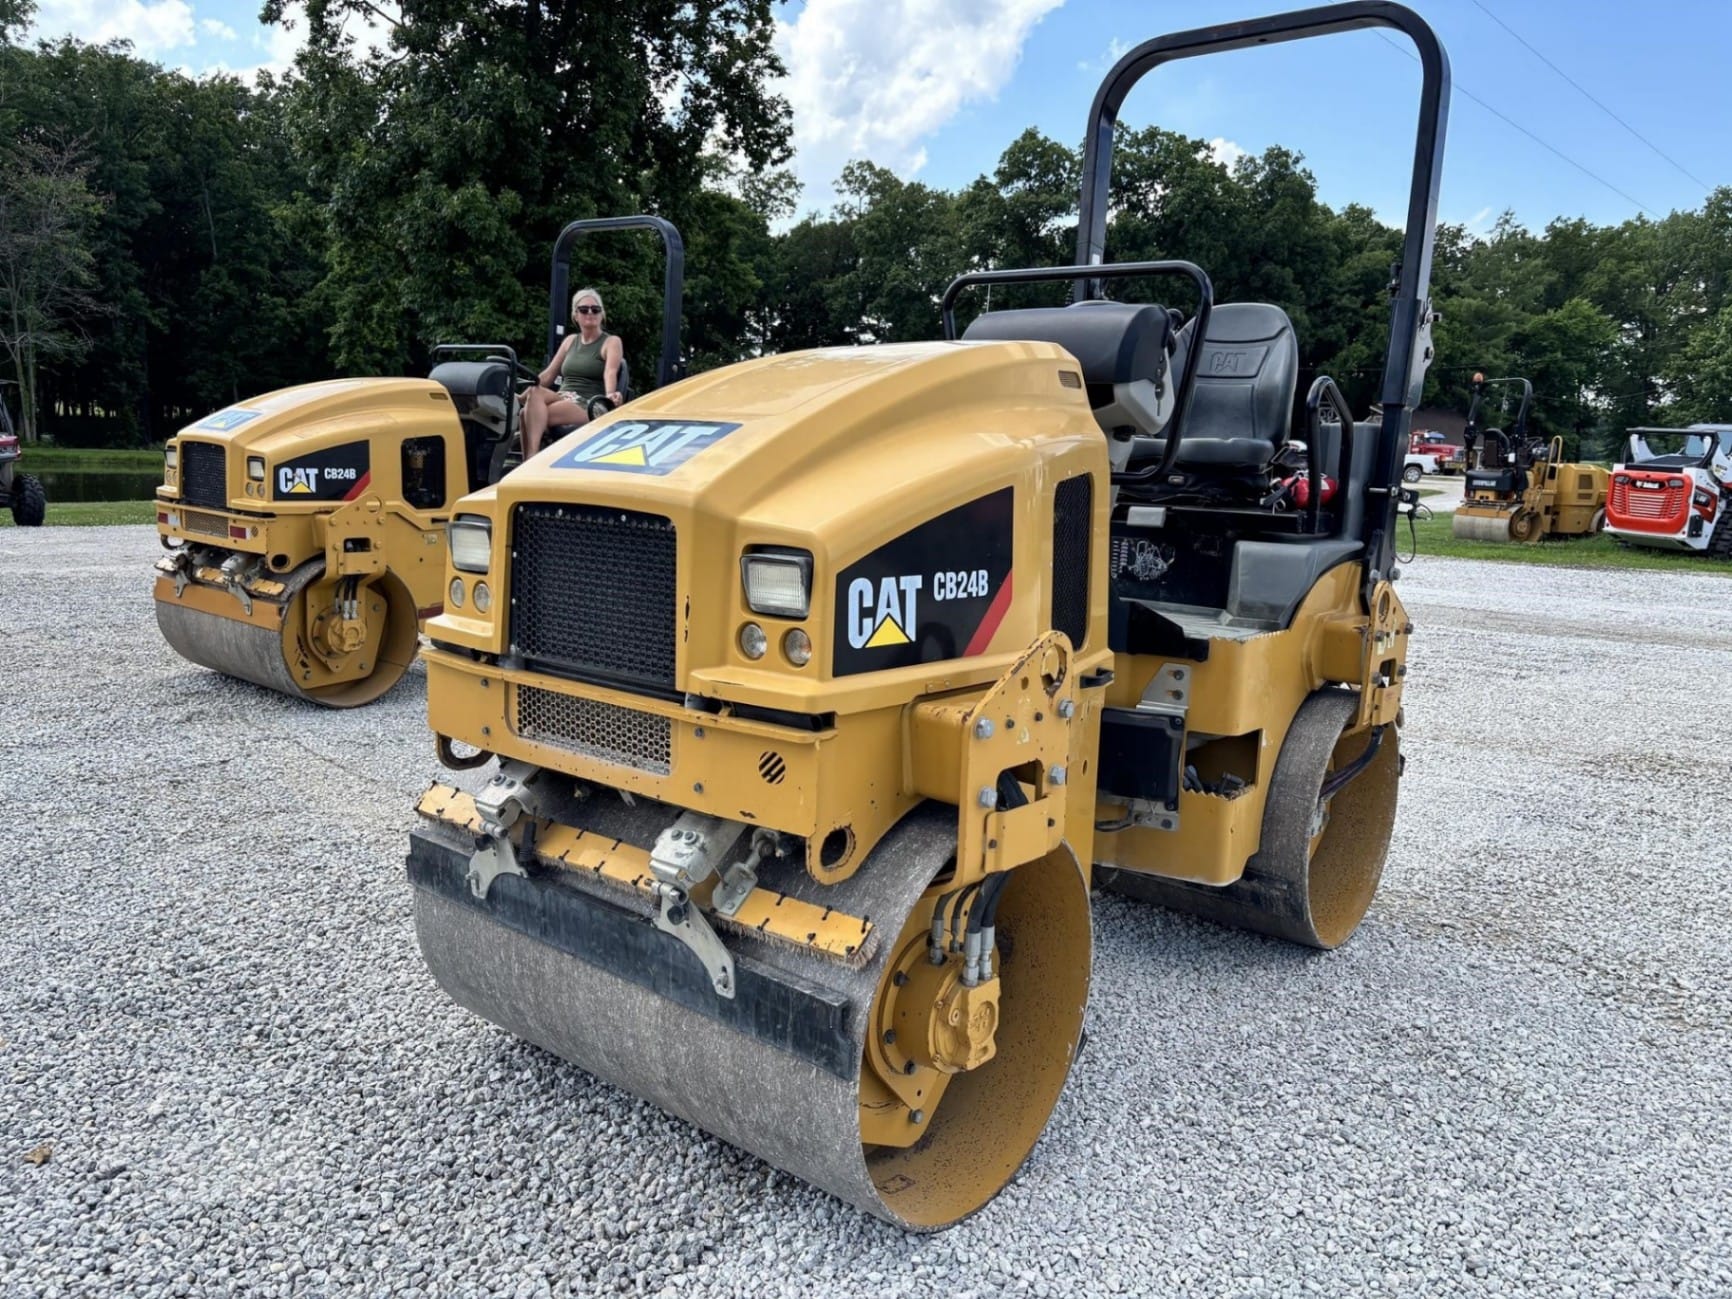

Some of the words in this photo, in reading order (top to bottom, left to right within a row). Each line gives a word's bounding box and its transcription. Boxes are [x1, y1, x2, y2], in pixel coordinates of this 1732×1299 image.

[1209, 351, 1248, 374] CAT
[573, 423, 721, 467] CAT
[278, 466, 319, 493] CAT
[324, 467, 357, 480] CB24B
[847, 574, 923, 650] CAT
[933, 569, 989, 602] CB24B
